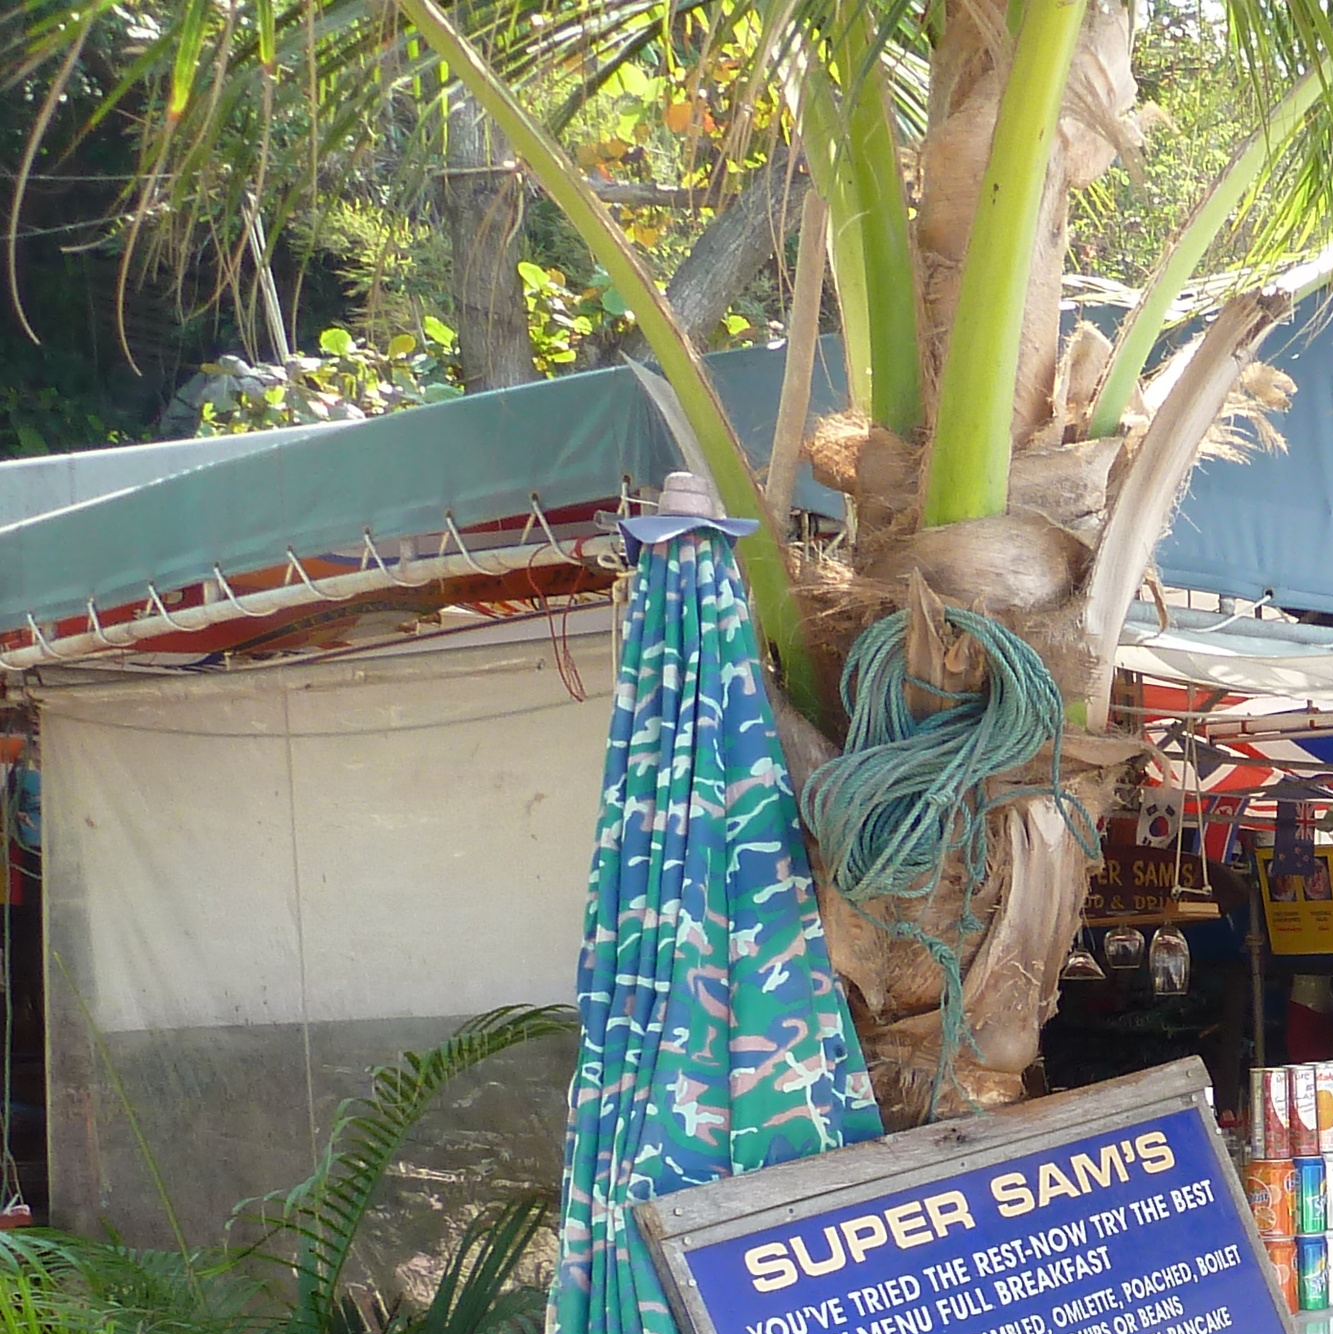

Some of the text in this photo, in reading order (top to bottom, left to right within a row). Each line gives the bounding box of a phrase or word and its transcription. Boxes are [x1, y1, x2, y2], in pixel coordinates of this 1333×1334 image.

[1132, 860, 1194, 887] SAMS
[744, 1132, 1175, 1292] SUPER SAM'S
[847, 1275, 920, 1316] TRIED
[923, 1258, 971, 1292] THE
[972, 1220, 1086, 1277] REST-NOW
[1089, 1207, 1128, 1238] TRY
[1129, 1194, 1170, 1225] THE
[1170, 1180, 1214, 1213] BEST
[936, 1288, 996, 1325] FULL
[994, 1246, 1111, 1305] BREAKFAST
[1052, 1288, 1124, 1327] OMLETTE,
[1121, 1263, 1198, 1302] POACHED,
[1195, 1245, 1241, 1276] BOILET
[1137, 1296, 1183, 1327] BEANS
